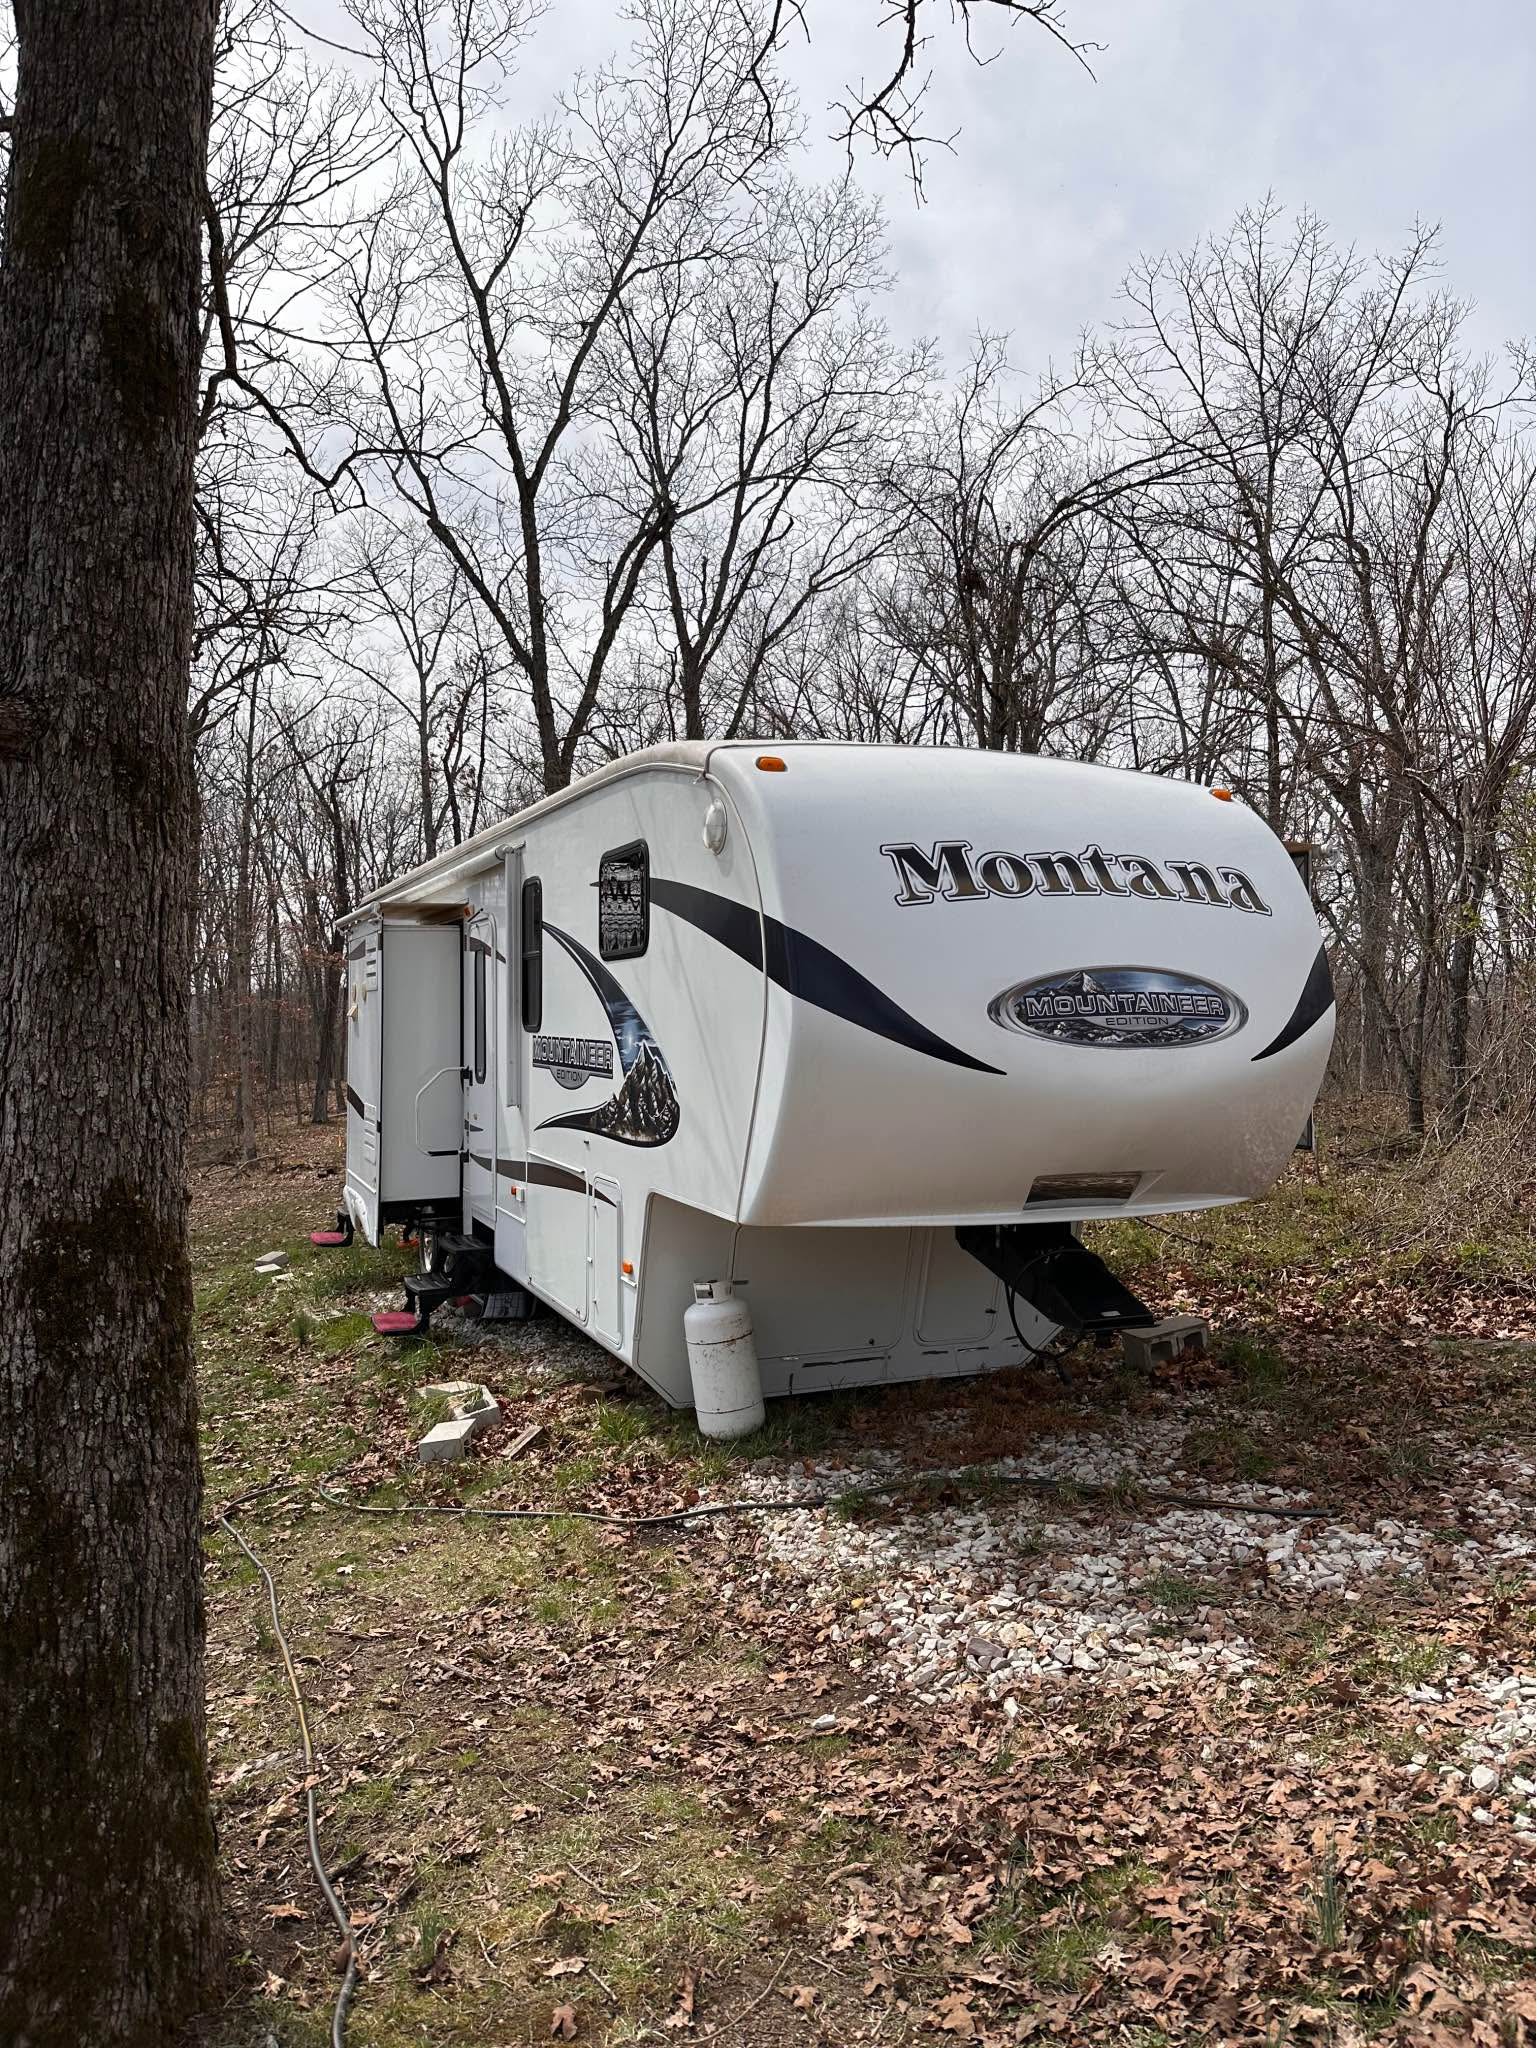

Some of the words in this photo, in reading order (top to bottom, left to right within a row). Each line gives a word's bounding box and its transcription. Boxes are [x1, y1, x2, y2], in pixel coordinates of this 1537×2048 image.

[880, 840, 1272, 916] Montana
[1025, 992, 1225, 1018] MOUNTAINEER
[1105, 1015, 1169, 1026] EDITION
[532, 1036, 613, 1069] MOUNTAINEER
[556, 1069, 583, 1082] EDITION
